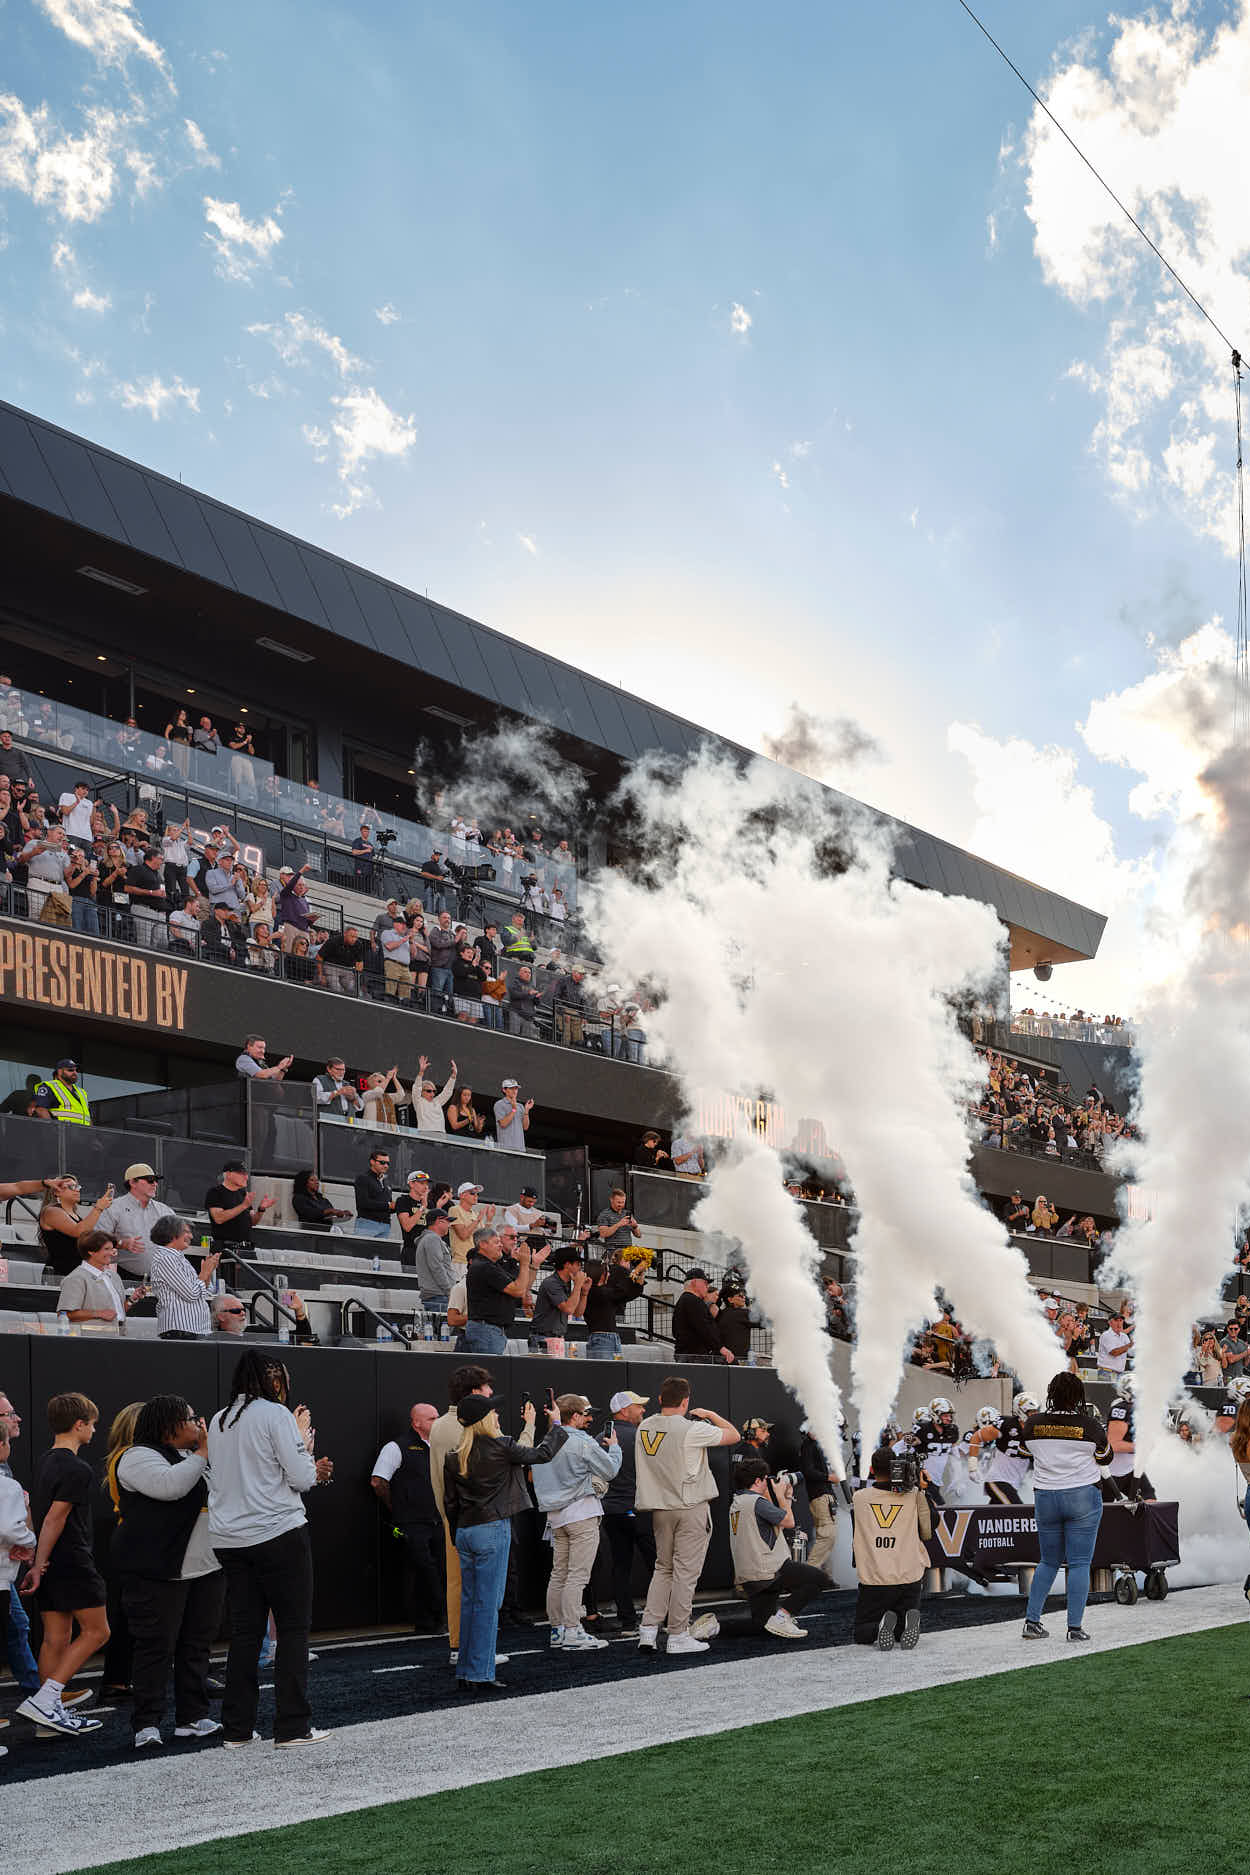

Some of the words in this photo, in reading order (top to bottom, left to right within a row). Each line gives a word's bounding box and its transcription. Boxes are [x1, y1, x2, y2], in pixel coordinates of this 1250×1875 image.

[0, 929, 148, 1022] PRESENTED
[155, 963, 188, 1030] BY
[1223, 1405, 1236, 1415] 70
[640, 1429, 668, 1457] V
[870, 1503, 904, 1529] V
[875, 1536, 896, 1549] 007
[934, 1509, 975, 1558] V
[978, 1537, 1015, 1549] FOOTBALL
